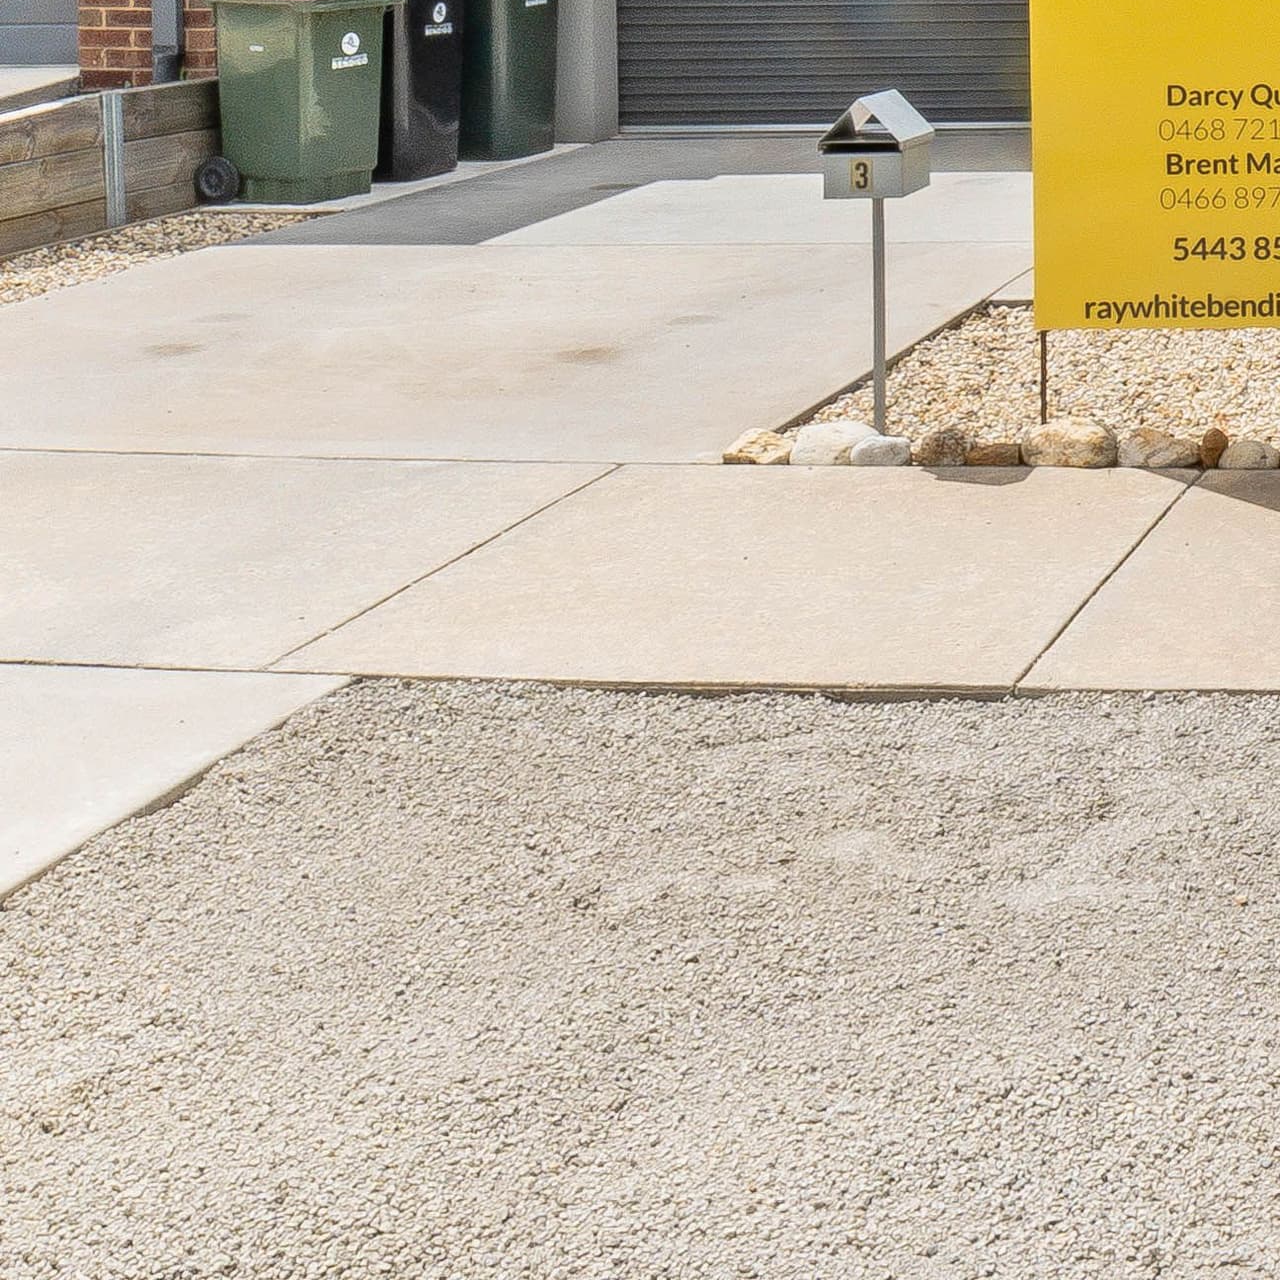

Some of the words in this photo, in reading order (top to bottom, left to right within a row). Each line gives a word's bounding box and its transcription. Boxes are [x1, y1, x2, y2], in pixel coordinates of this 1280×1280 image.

[1167, 84, 1244, 110] Darcy
[1158, 118, 1226, 142] 0468
[1233, 118, 1280, 141] 721
[854, 162, 869, 189] 3
[1166, 153, 1240, 176] Brent
[1160, 187, 1227, 210] 0466
[1173, 236, 1247, 262] 5443
